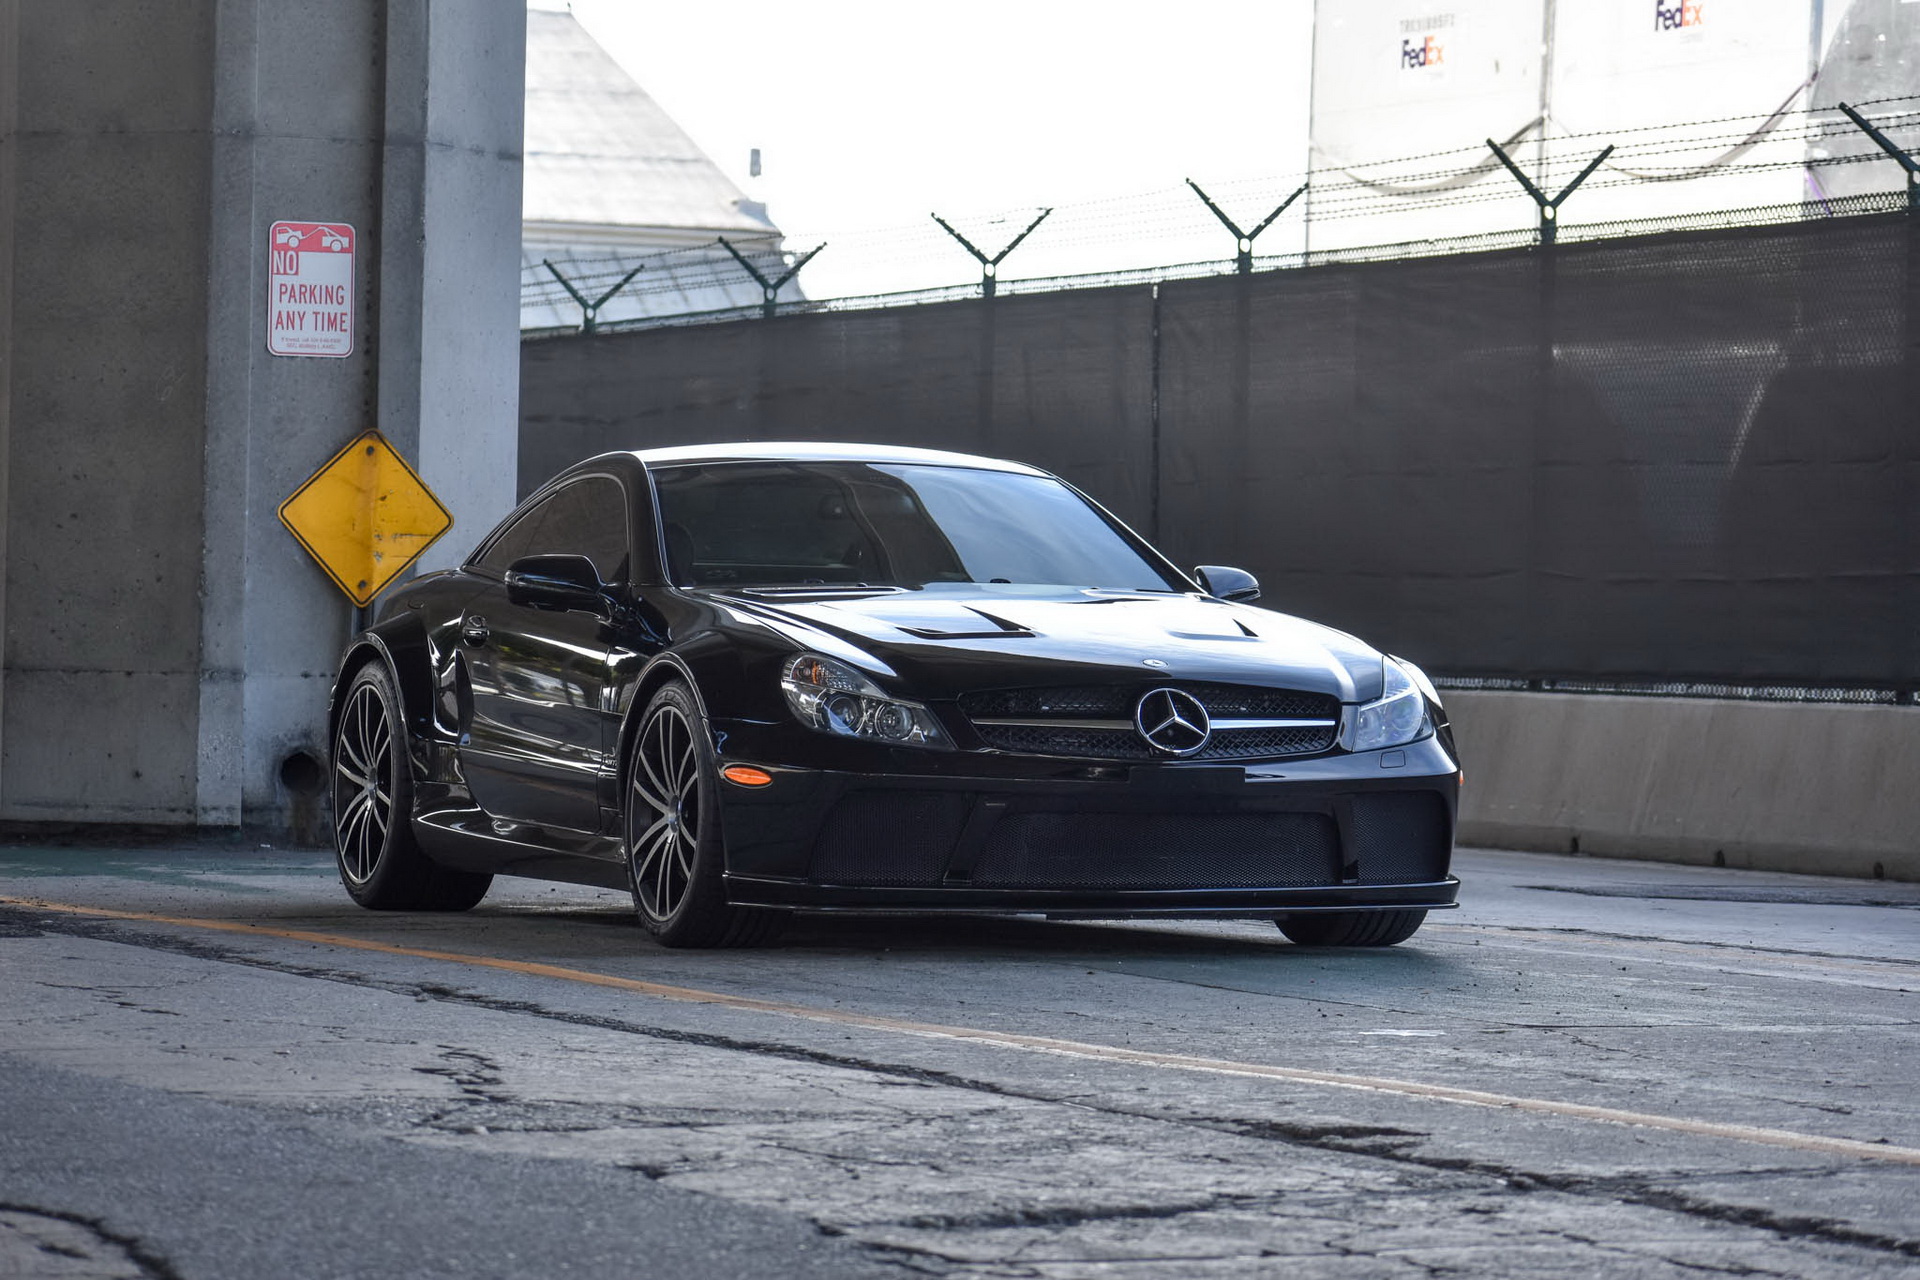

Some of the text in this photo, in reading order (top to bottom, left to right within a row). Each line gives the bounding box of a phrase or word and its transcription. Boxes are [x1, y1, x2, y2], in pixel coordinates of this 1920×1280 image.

[1655, 0, 1702, 31] FedEx
[1401, 36, 1444, 69] FedEx
[273, 250, 297, 274] NO
[279, 283, 345, 305] PARKING
[275, 310, 348, 332] ANY TIME
